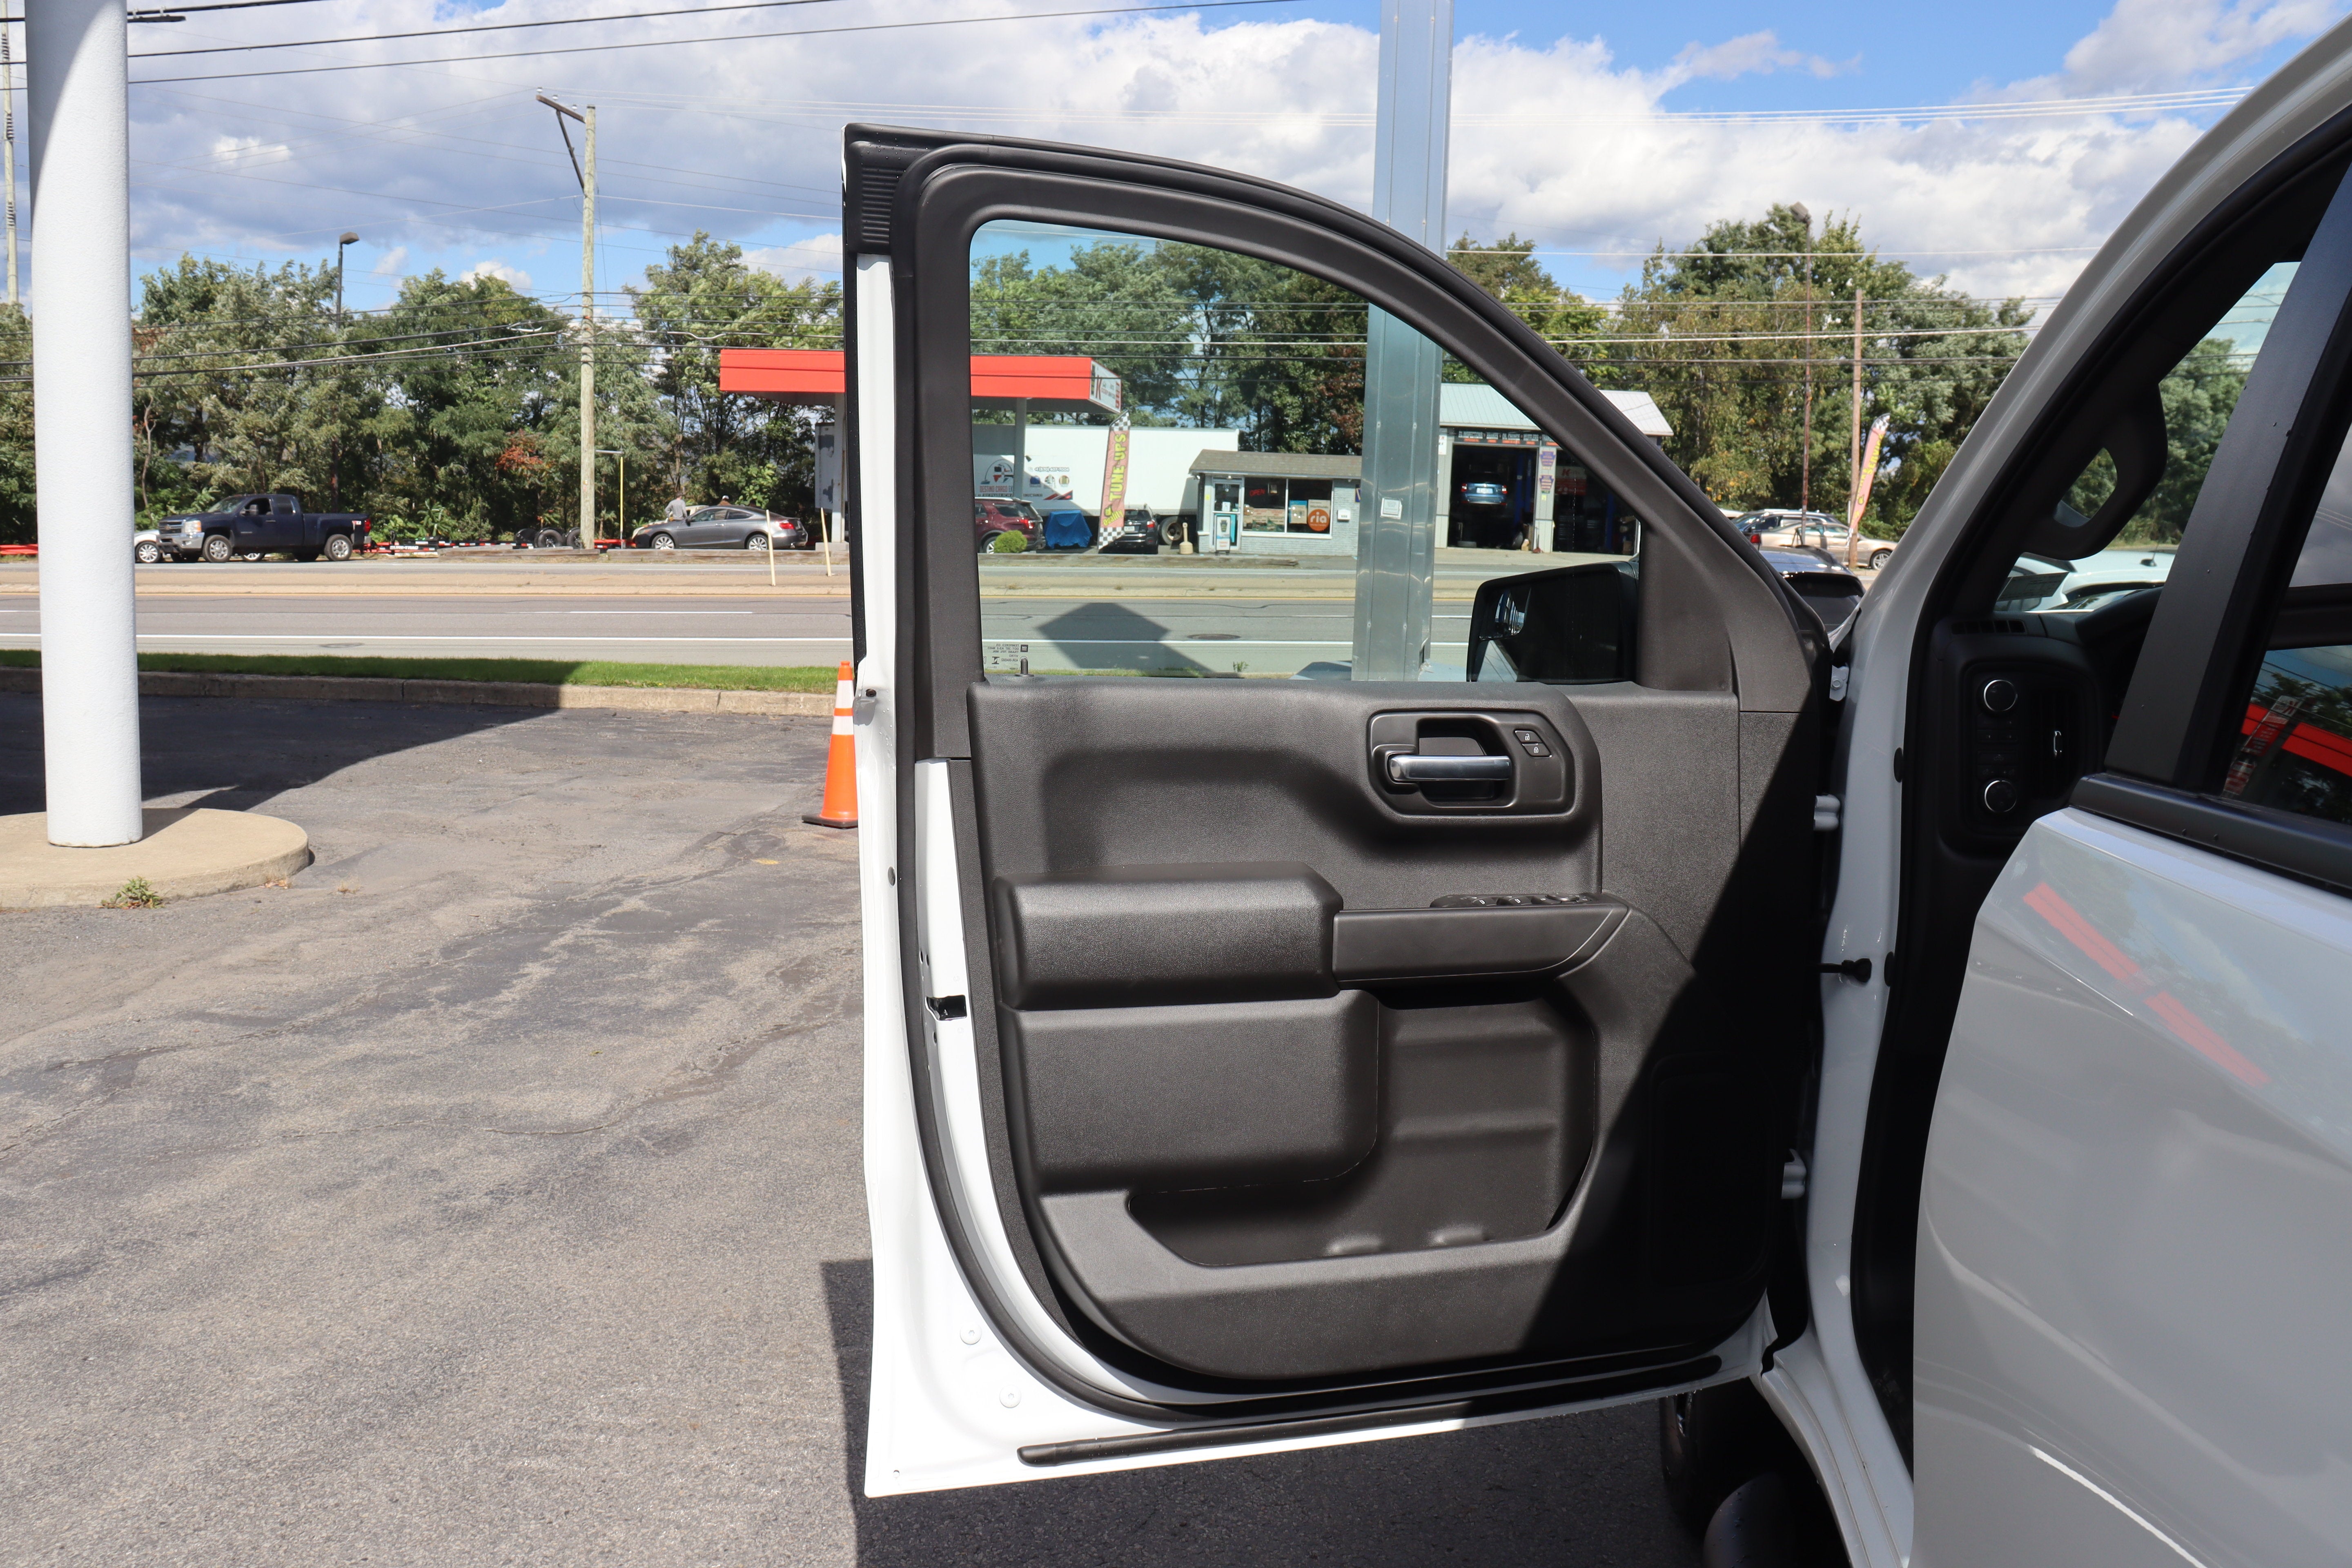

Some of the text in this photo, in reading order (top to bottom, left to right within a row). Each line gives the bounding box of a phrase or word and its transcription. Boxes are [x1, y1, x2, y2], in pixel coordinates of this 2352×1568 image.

[1109, 433, 1127, 501] TUNE-UPS
[1103, 510, 1123, 526] Quality
[1310, 512, 1327, 523] ria
